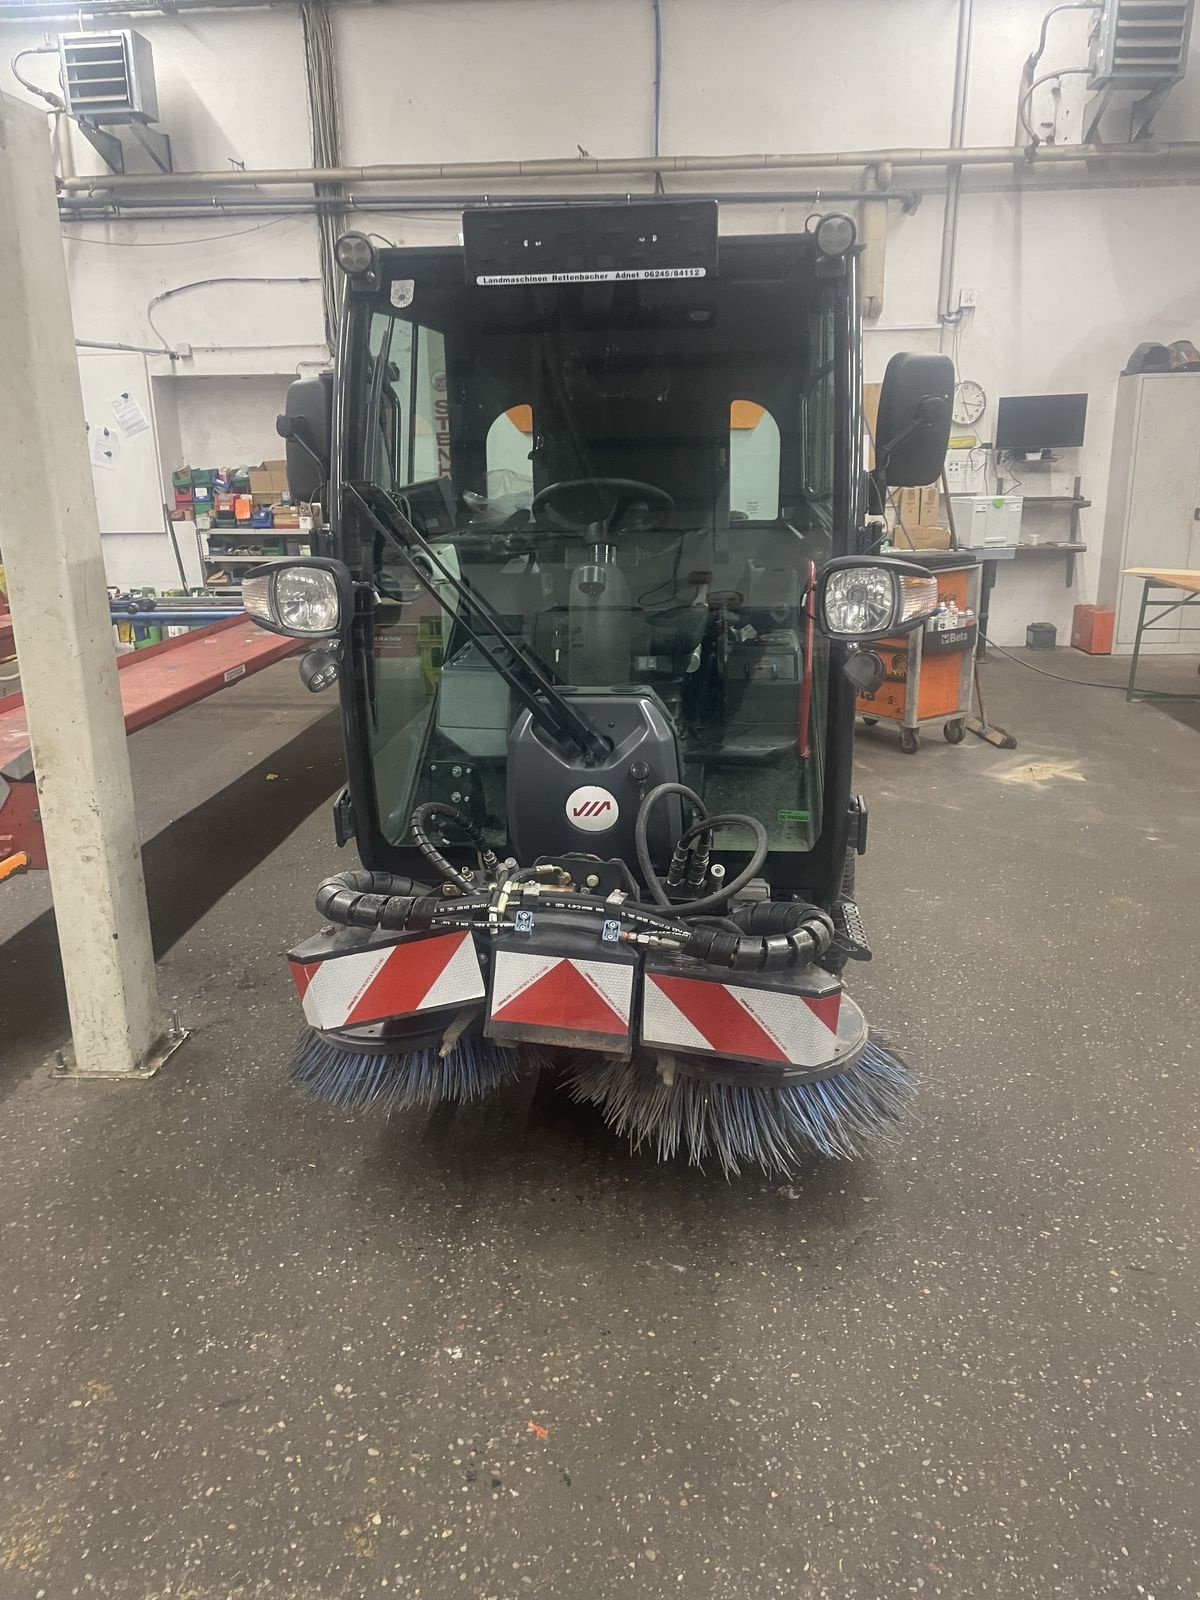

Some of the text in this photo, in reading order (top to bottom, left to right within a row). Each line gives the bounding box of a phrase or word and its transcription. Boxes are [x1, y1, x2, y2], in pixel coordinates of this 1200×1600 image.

[483, 269, 700, 284] Landmaschinen Rettenbacher Adnet 06245/84112
[950, 632, 968, 643] Beta
